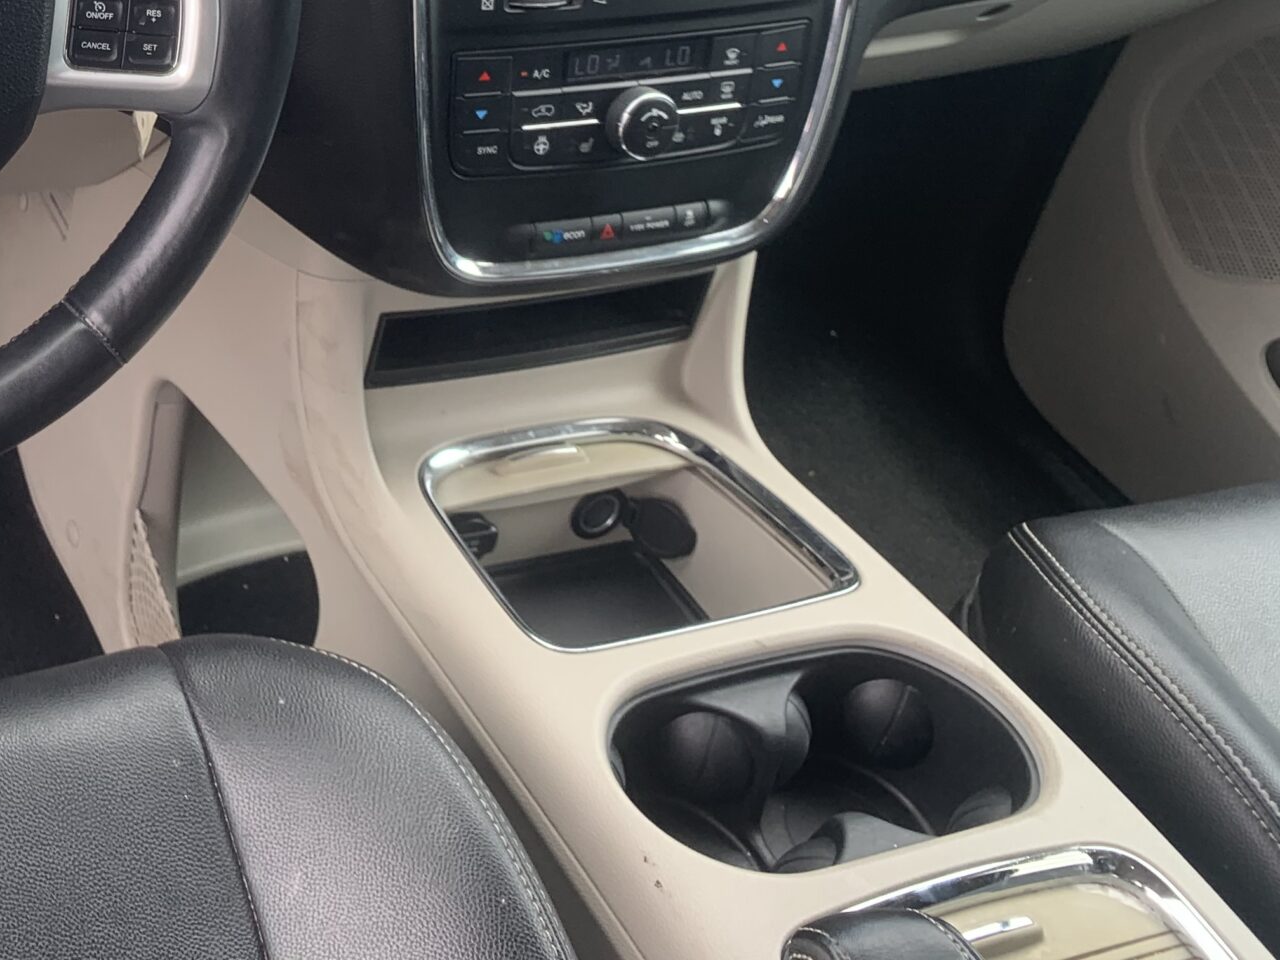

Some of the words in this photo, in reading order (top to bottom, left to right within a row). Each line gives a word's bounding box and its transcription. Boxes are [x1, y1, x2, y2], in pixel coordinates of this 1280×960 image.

[85, 11, 114, 20] ON/OFF
[146, 9, 162, 18] RES
[81, 41, 111, 51] CANCEL
[143, 43, 158, 51] SET
[532, 68, 550, 79] A/C
[477, 145, 498, 155] SYNC
[563, 229, 586, 241] econ
